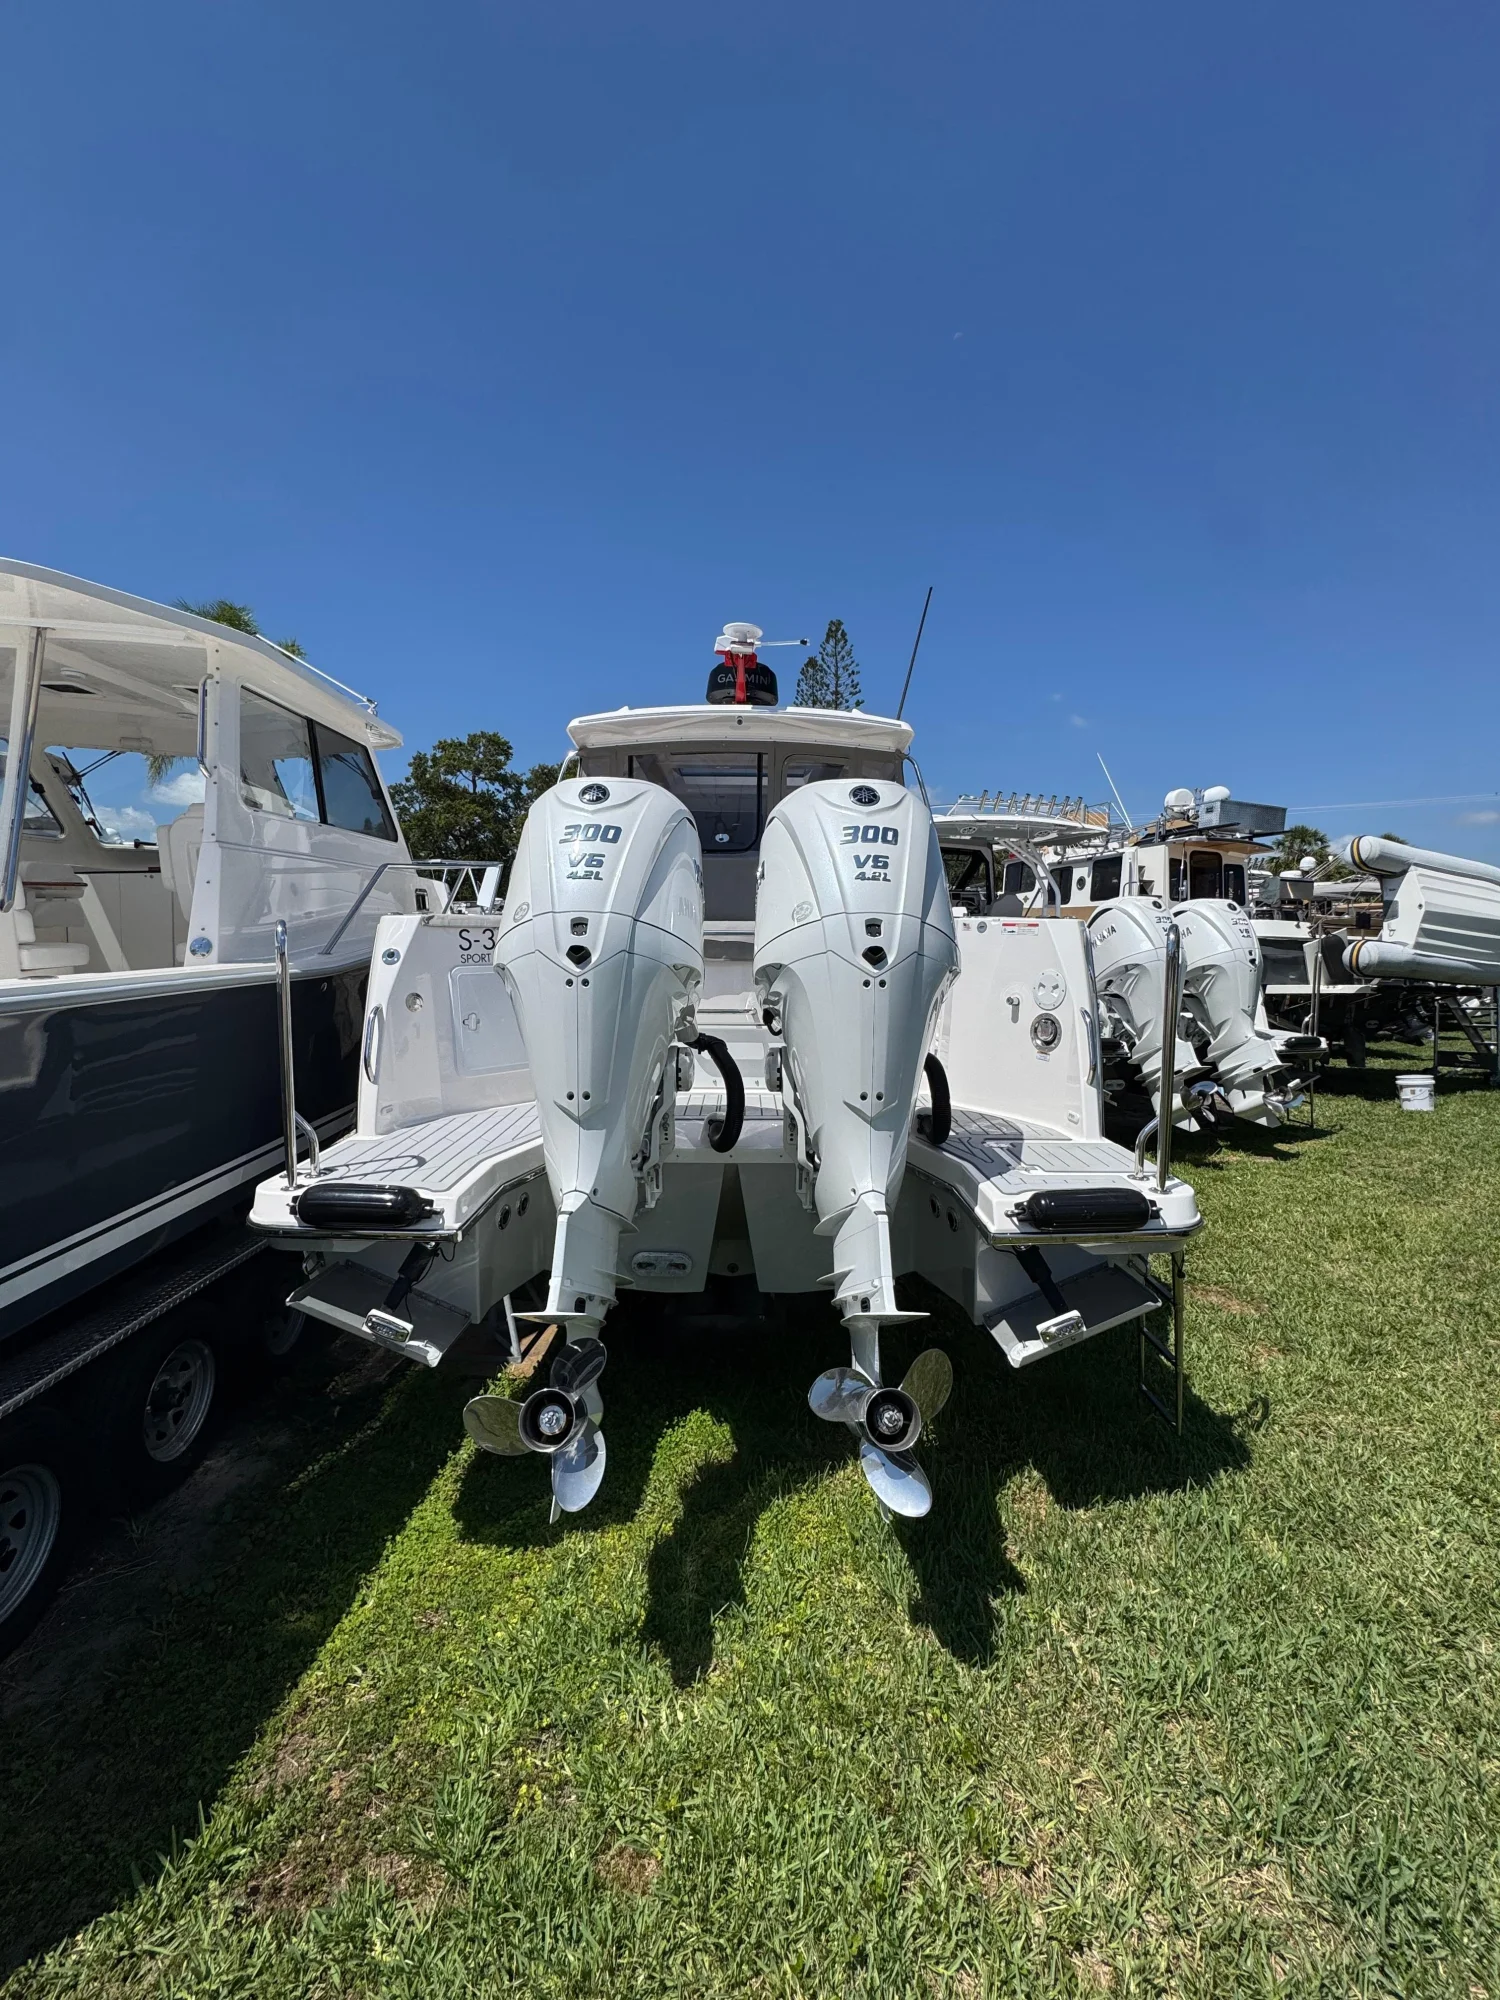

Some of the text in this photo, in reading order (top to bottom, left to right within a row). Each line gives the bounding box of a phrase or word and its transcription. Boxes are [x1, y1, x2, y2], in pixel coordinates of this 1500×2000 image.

[717, 673, 768, 685] GAMIN
[559, 824, 622, 844] 300
[840, 825, 899, 845] 300
[568, 853, 606, 868] V6
[853, 855, 890, 869] V6
[566, 870, 603, 881] 4.2L
[855, 871, 891, 882] 4.2L
[460, 953, 491, 963] SPORT
